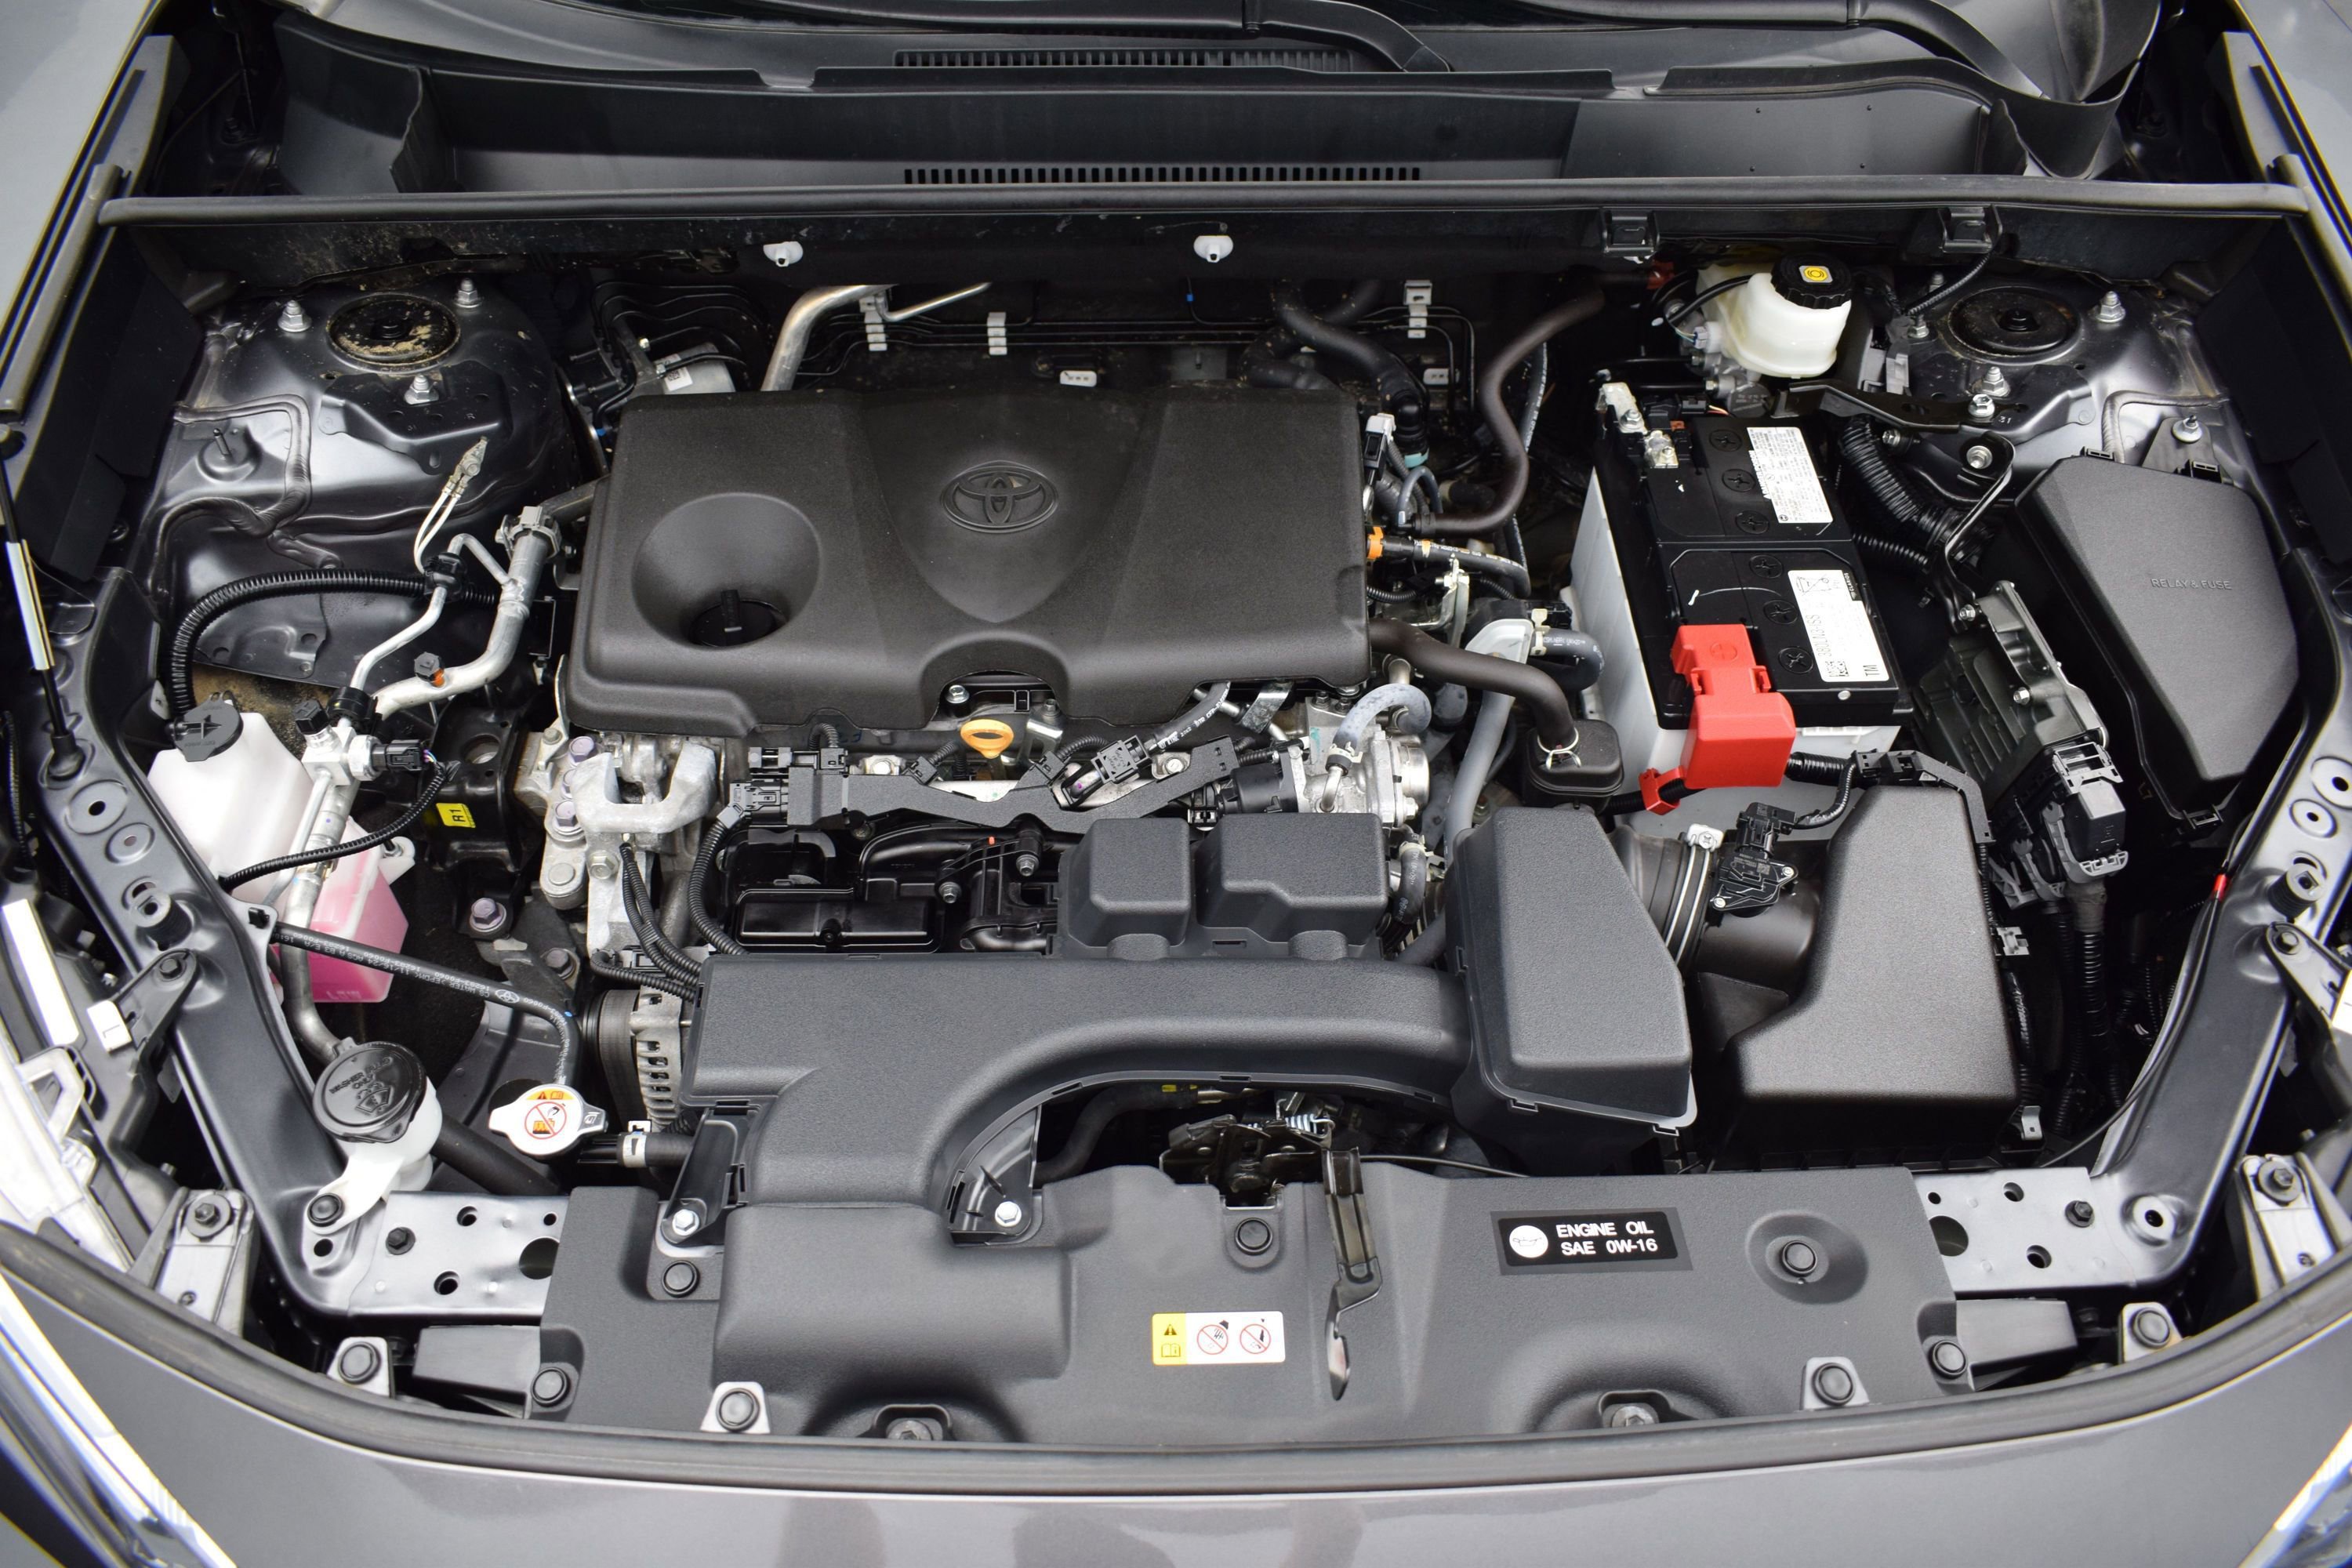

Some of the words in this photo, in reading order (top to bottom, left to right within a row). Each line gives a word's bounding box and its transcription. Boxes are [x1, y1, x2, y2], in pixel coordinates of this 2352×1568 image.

[1844, 572, 1855, 592] CLARIOS
[2151, 578, 2188, 588] RELAY
[2190, 580, 2198, 589] &
[2200, 580, 2232, 590] FUSE
[1862, 664, 1881, 677] TM
[292, 931, 350, 952] 16283-F0060
[362, 951, 421, 972] 16283-F0060
[366, 957, 409, 975] 11/16/24
[434, 971, 489, 991] 16283-F0060
[448, 980, 476, 993] WATER
[328, 1072, 365, 1094] WASHER
[353, 1073, 376, 1091] ONLY
[1555, 1222, 1617, 1238] ENGINE
[1625, 1221, 1654, 1236] OIL
[1560, 1240, 1596, 1256] SAE
[1606, 1239, 1658, 1254] 0W-16
